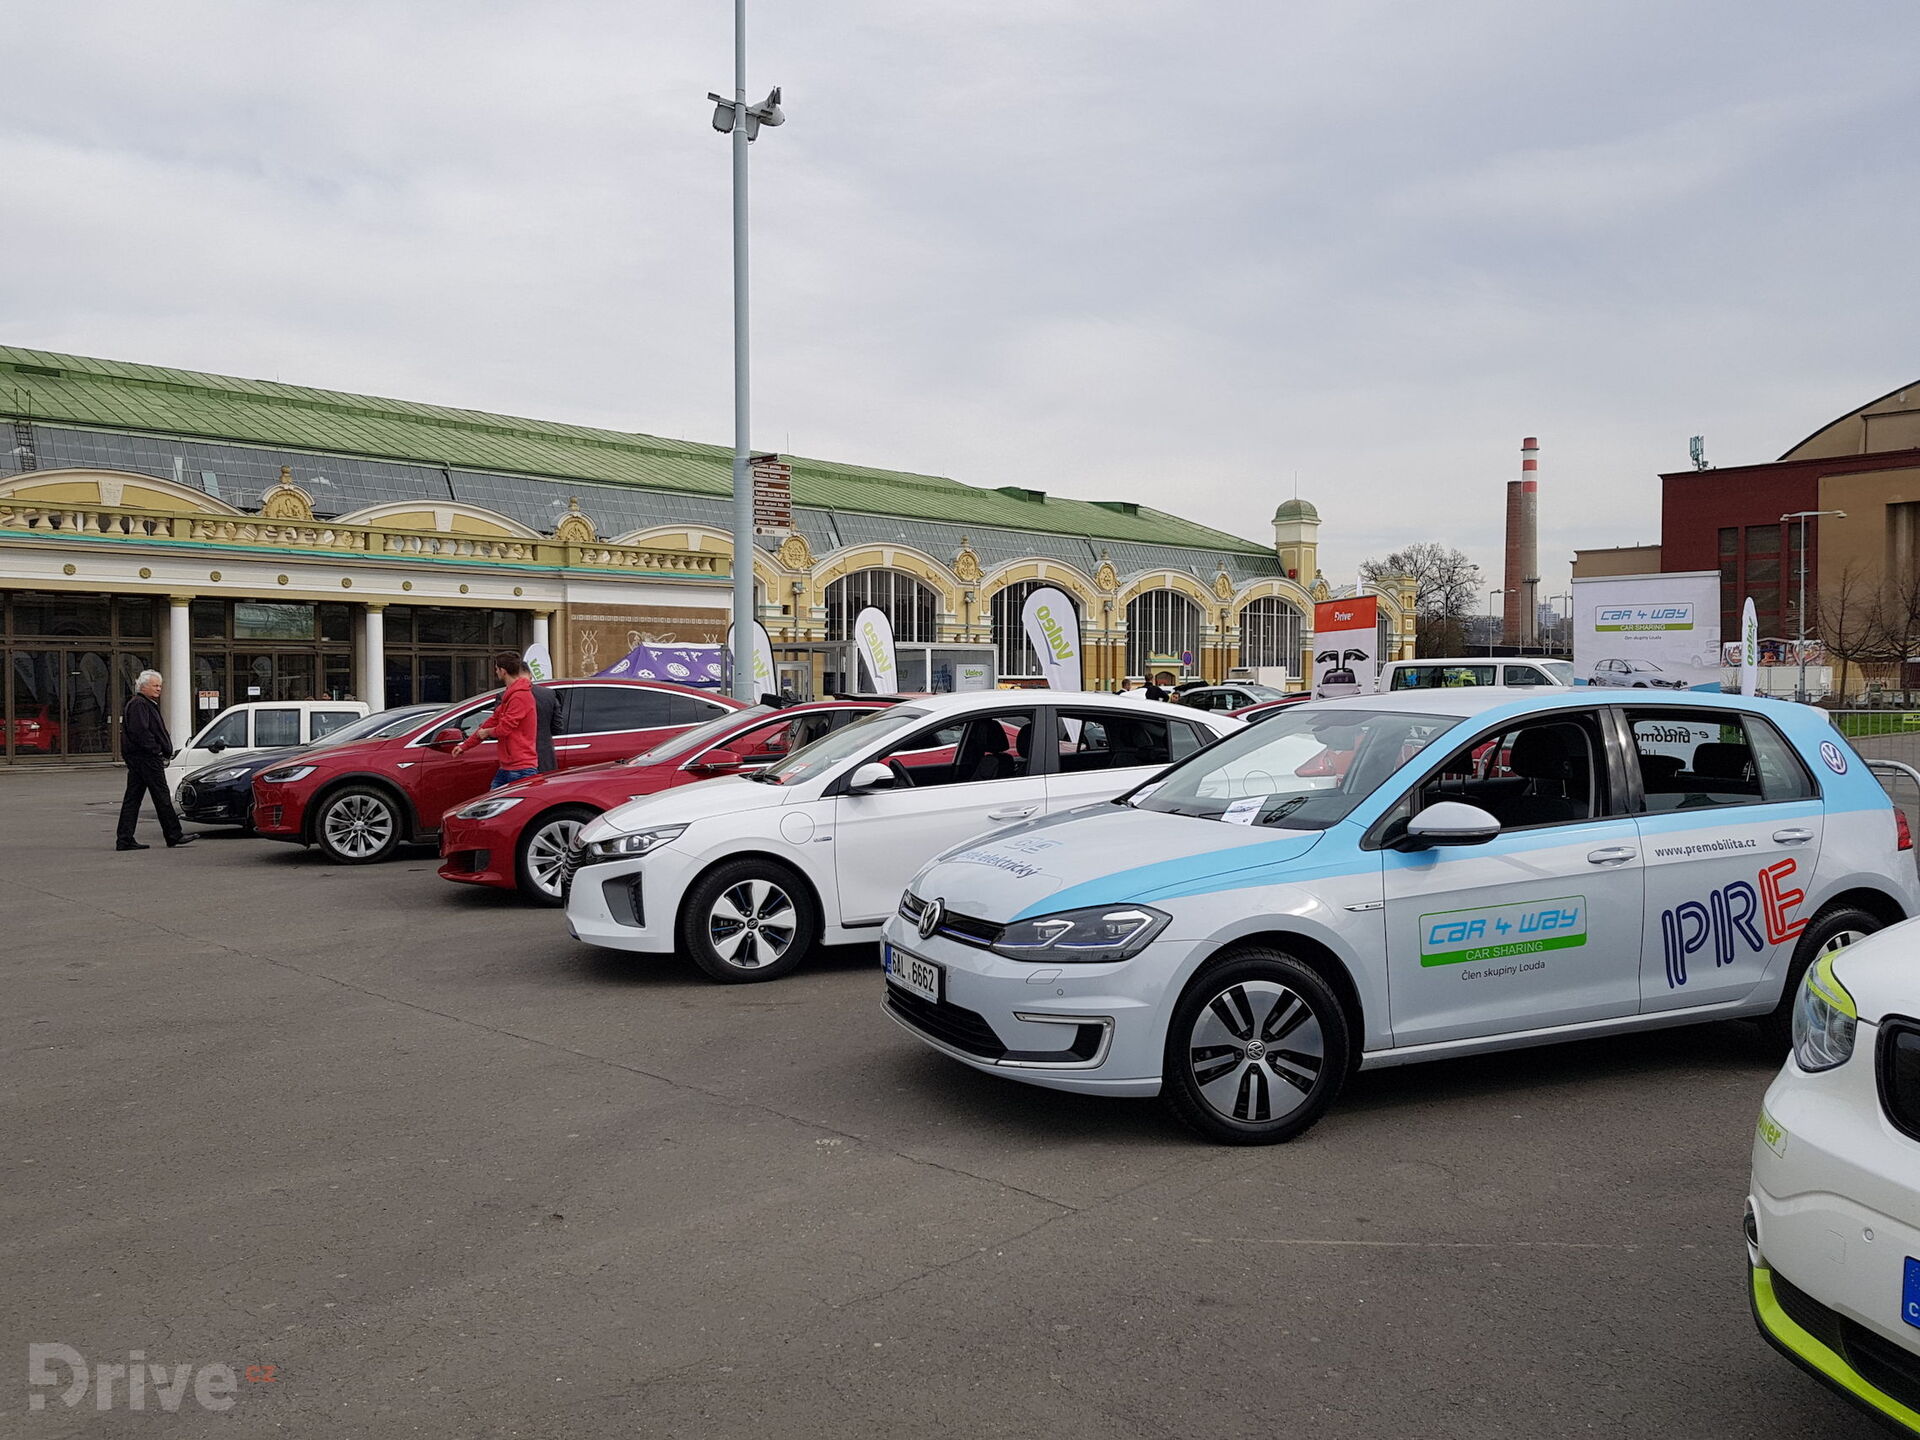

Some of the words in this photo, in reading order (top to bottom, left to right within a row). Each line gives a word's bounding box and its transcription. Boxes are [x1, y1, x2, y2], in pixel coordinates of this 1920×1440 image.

[1637, 609, 1648, 620] 4
[1635, 623, 1666, 631] SHARING
[529, 658, 545, 680] Val
[964, 668, 984, 677] Valeo
[1655, 838, 1757, 857] www.premobilita.cz
[1495, 916, 1513, 936] 4
[1661, 857, 1811, 990] PRE
[1465, 948, 1491, 961] CAR
[1492, 941, 1544, 958] SHARING
[912, 961, 935, 993] 6662
[1461, 969, 1482, 981] Člen
[1483, 964, 1518, 977] skupiny
[1519, 960, 1546, 972] Louda
